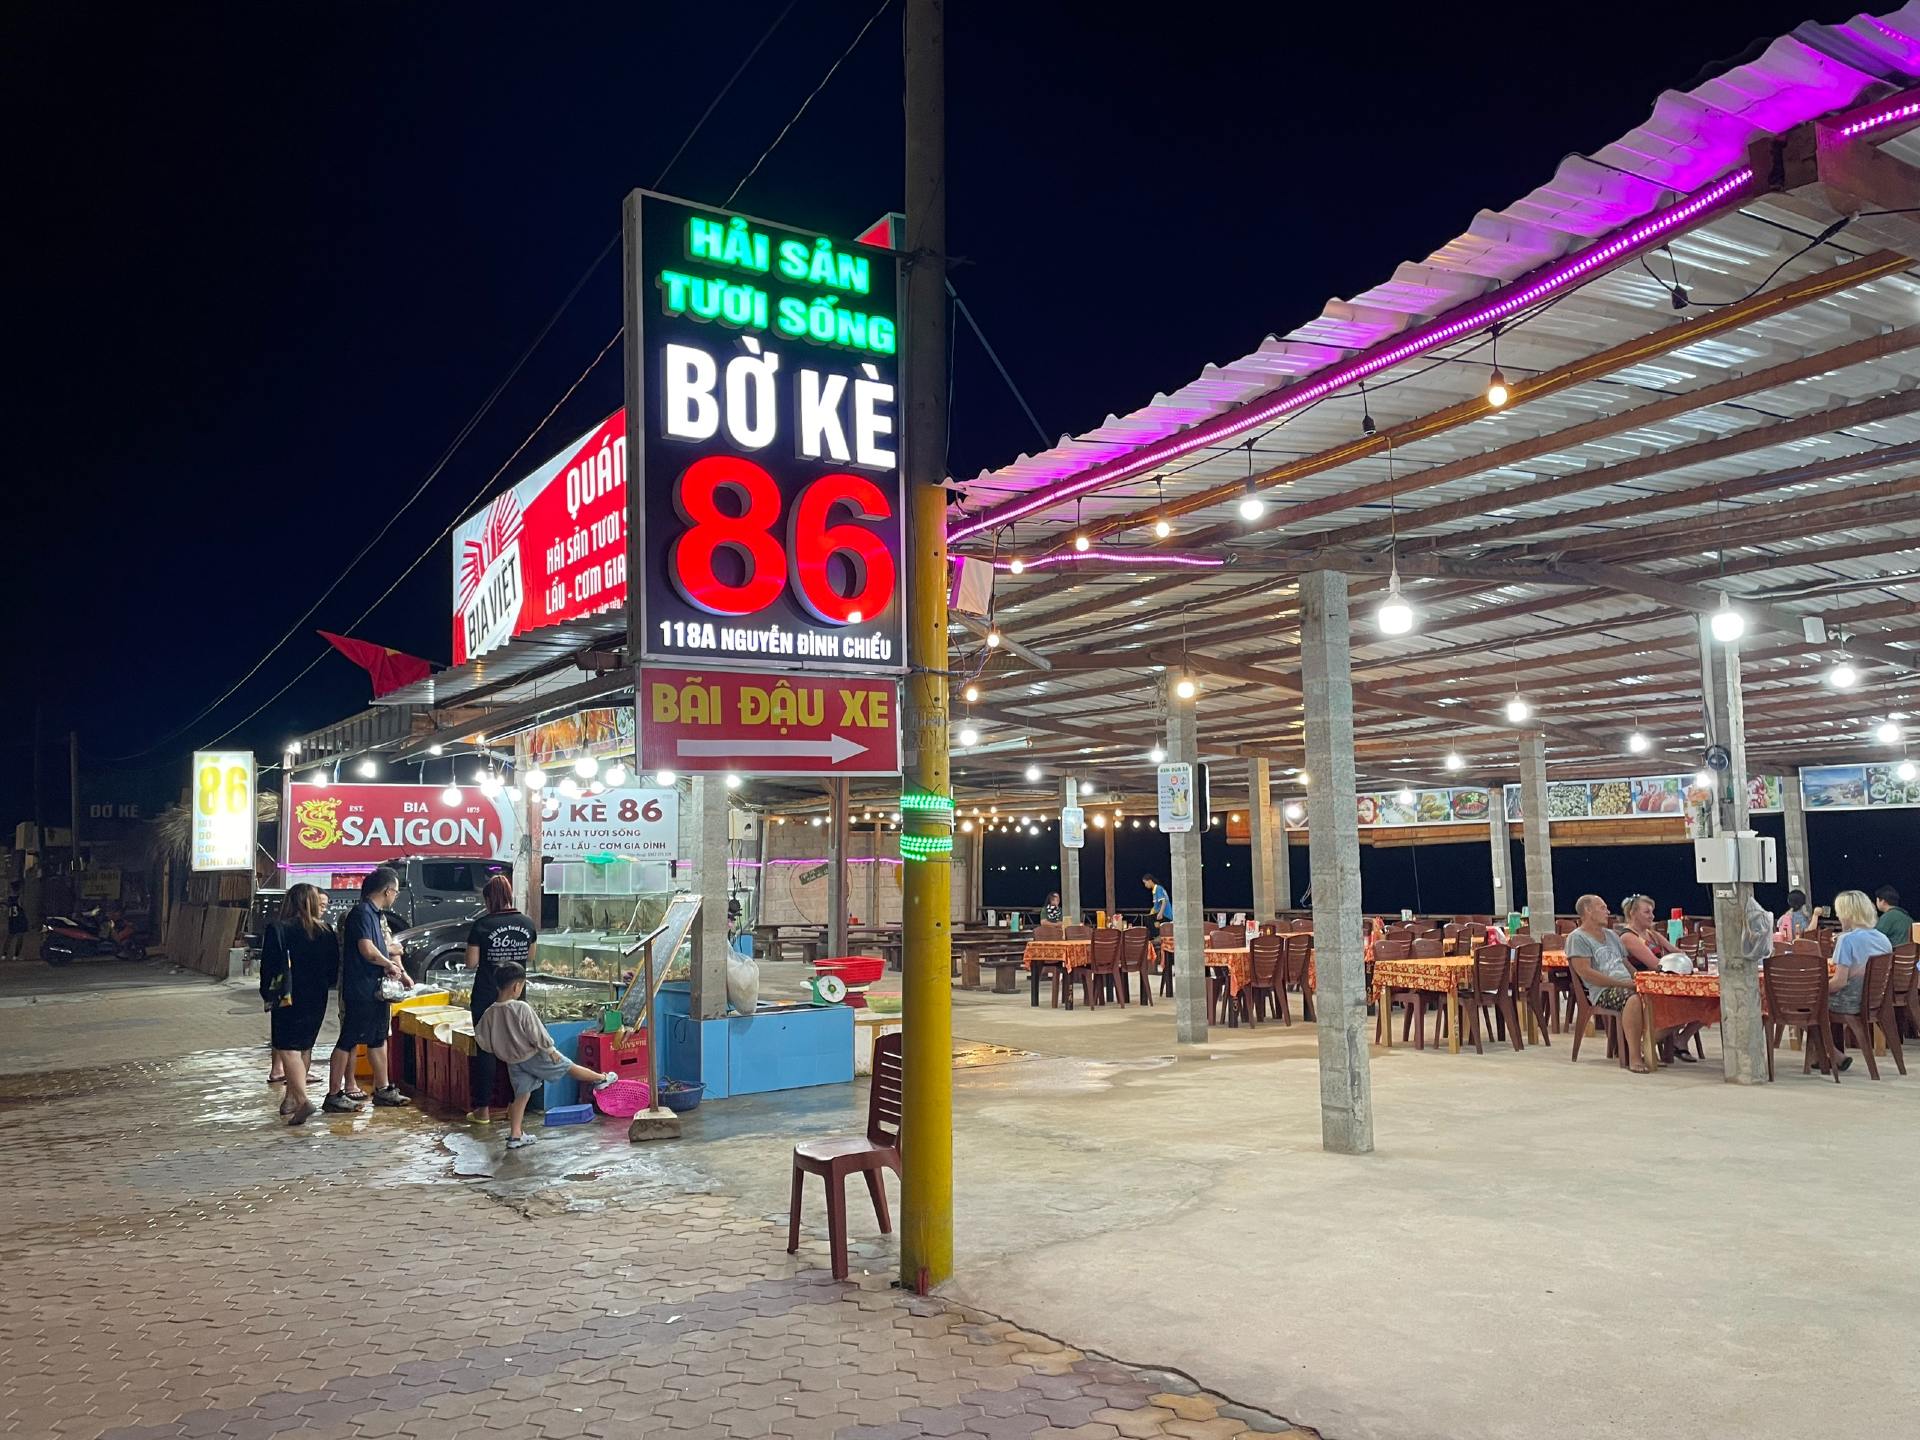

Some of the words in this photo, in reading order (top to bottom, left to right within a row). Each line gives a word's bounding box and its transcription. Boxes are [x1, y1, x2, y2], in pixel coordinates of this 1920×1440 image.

[688, 216, 770, 273] HẢI
[778, 237, 870, 295] SẢN
[660, 269, 769, 330] TƯƠI
[777, 294, 896, 354] SỐNG
[666, 335, 780, 449] BỜ
[799, 362, 897, 470] KÈ
[566, 434, 627, 521] QUÁN
[546, 537, 565, 575] HẢI
[566, 525, 589, 565] SẢN
[590, 510, 620, 552] TƯƠI
[675, 455, 896, 625] 86
[466, 597, 490, 653] BIA
[487, 549, 518, 627] VIỆT
[545, 576, 566, 616] LẨU
[574, 564, 602, 602] CƠM
[604, 553, 627, 590] GIA
[660, 620, 717, 650] 118A
[720, 624, 794, 655] NGUYỄN
[797, 632, 839, 657] ĐÌNH
[842, 631, 892, 660] CHIỂU
[652, 676, 722, 726] BÃI
[737, 679, 825, 735] ĐẬU
[839, 688, 889, 729] XE
[198, 766, 248, 816] 86
[403, 802, 429, 813] BIA
[569, 799, 608, 823] KÈ
[617, 798, 663, 823] 86
[341, 816, 484, 847] SAIGON
[624, 842, 640, 850] GIA
[492, 935, 510, 948] 86
